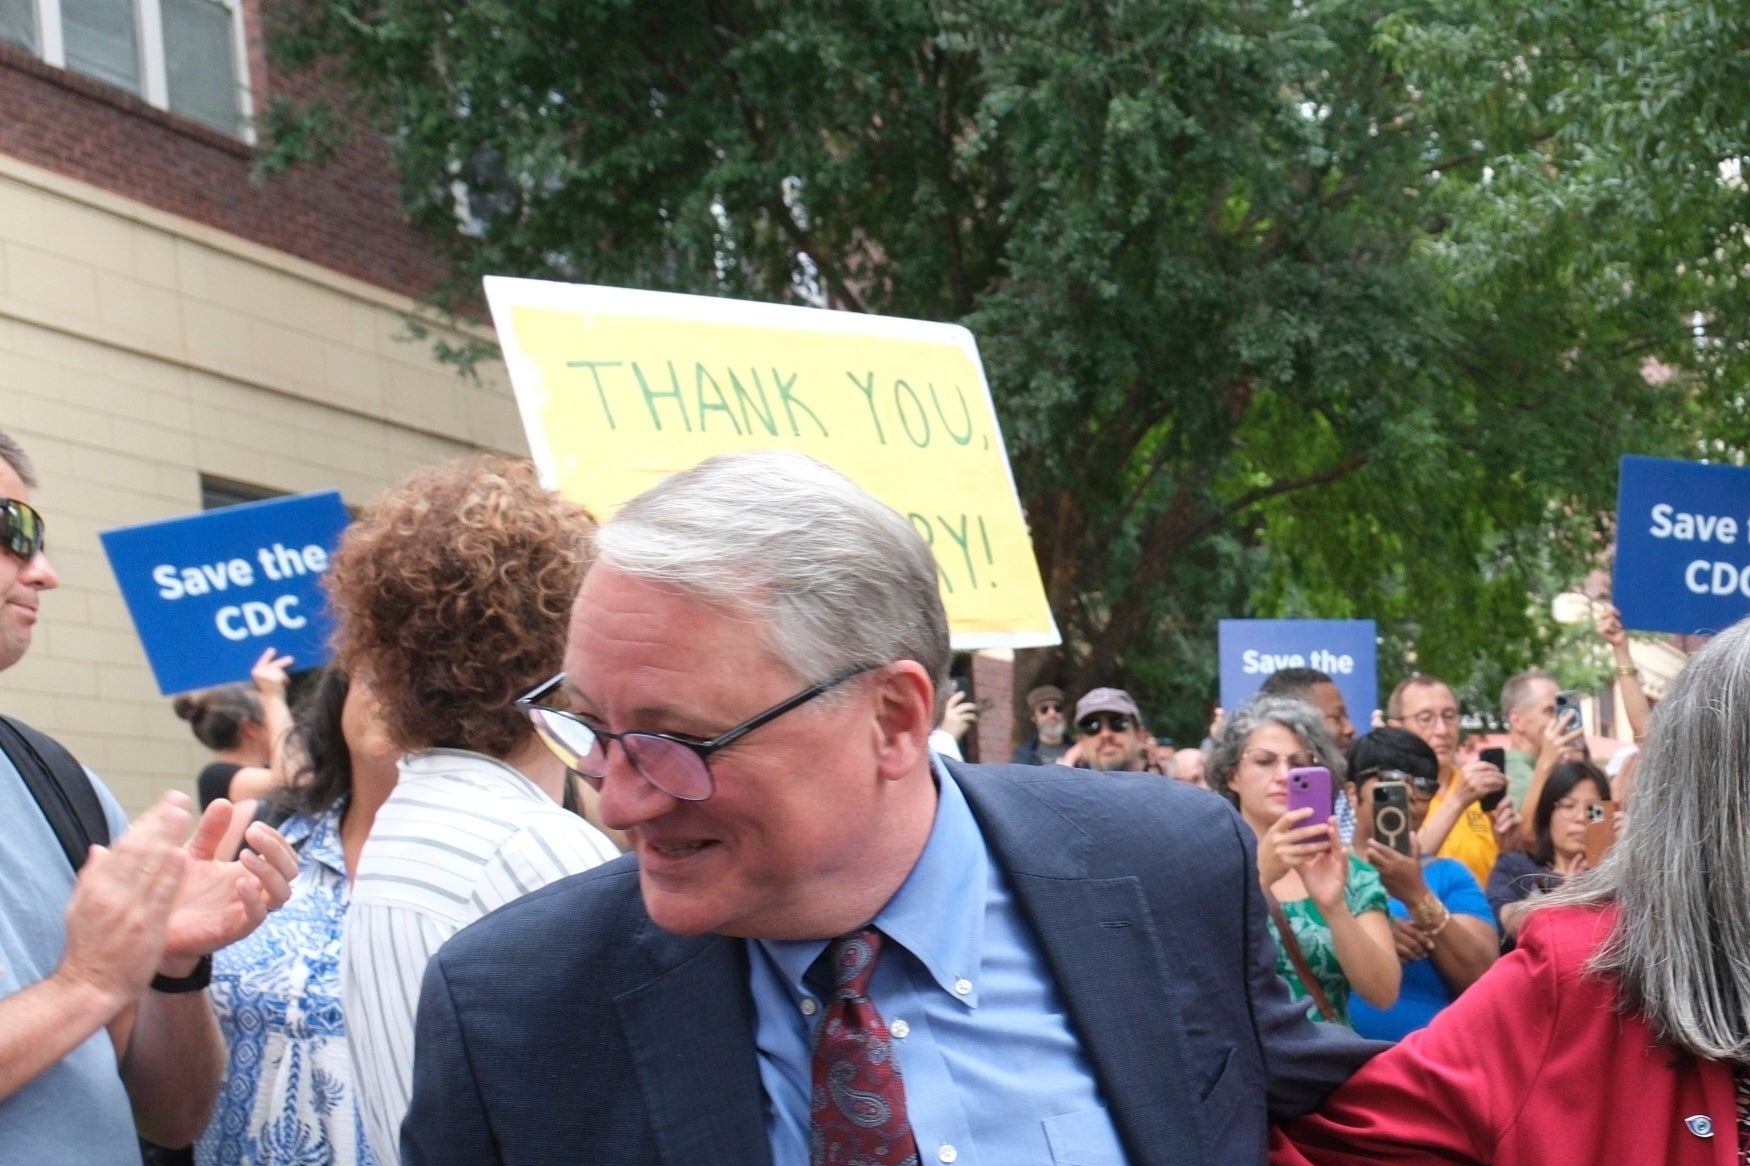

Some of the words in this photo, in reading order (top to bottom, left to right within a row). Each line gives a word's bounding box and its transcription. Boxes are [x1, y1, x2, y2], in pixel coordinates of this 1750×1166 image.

[566, 360, 830, 439] THANK
[845, 370, 990, 451] YOU,
[1649, 502, 1739, 545] Save
[152, 557, 255, 601] Save
[256, 542, 329, 582] the
[907, 511, 998, 595] RY!
[214, 593, 308, 642] CDC
[1241, 648, 1305, 675] Save
[1310, 648, 1355, 675] the
